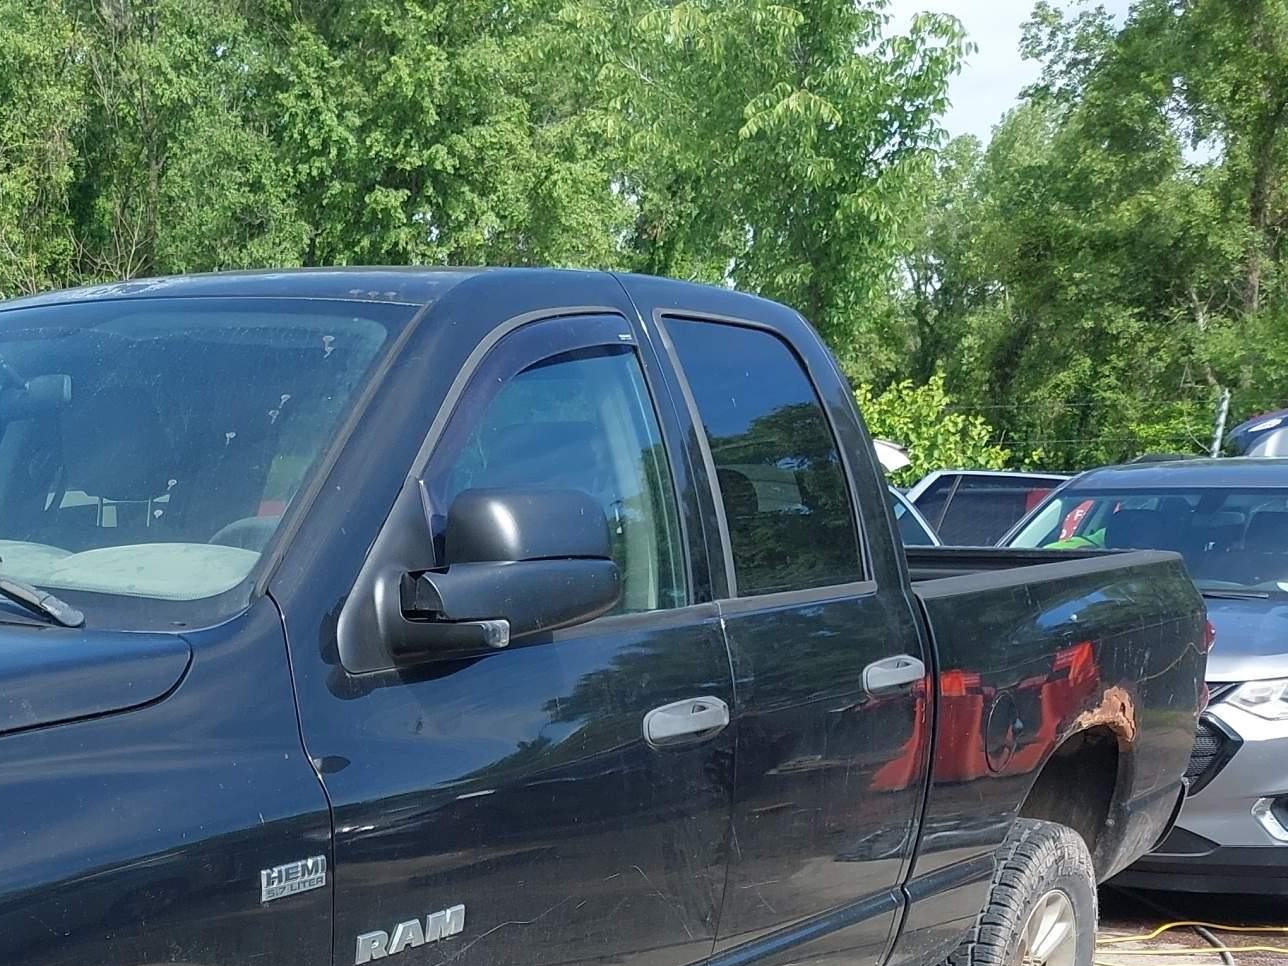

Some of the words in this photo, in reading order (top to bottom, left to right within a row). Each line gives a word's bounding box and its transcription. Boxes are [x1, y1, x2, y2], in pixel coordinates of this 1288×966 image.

[261, 855, 326, 890] HEMI
[290, 874, 324, 892] LITER
[354, 903, 466, 966] RAM
